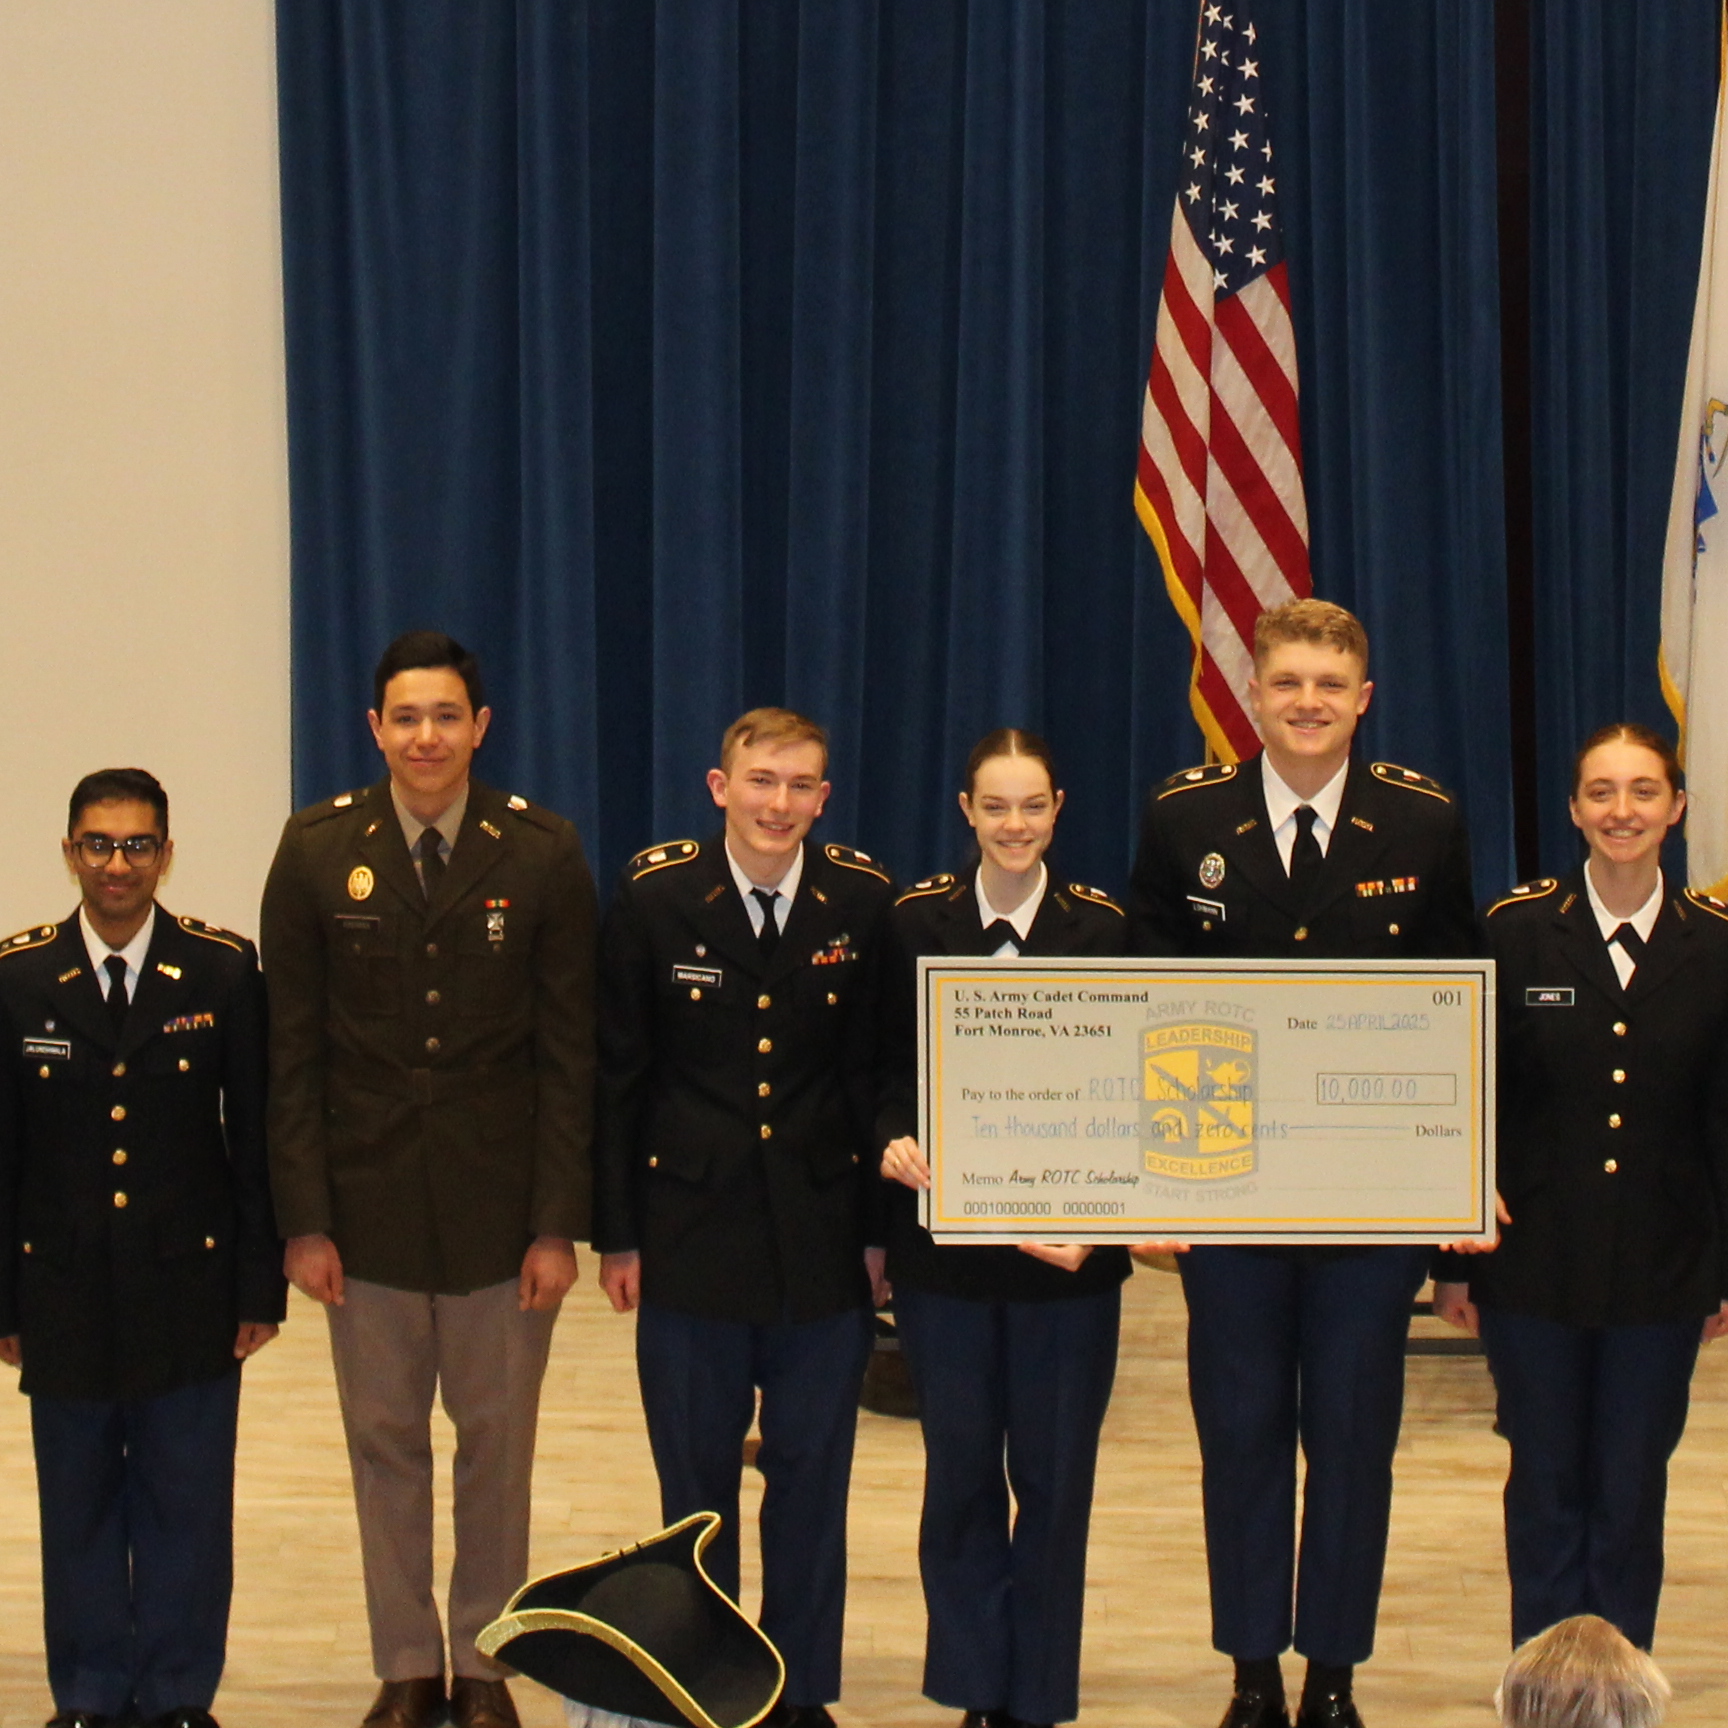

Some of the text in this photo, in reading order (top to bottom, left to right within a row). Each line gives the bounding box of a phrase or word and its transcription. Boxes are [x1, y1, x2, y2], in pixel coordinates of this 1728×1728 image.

[954, 990, 1149, 1005] U. S. Army Cadet Command
[1432, 990, 1463, 1007] 001
[954, 1007, 1053, 1020] 55 Patch Road
[1145, 1000, 1256, 1023] ARMY ROTC
[954, 1024, 1113, 1039] Fort Monroe, VA 23651
[1287, 1017, 1318, 1030] Date
[1146, 1028, 1251, 1049] LEADERSHIP
[962, 1076, 1253, 1106] Pay to the order of ROTC Scholarship
[972, 1115, 998, 1138] Ten
[1005, 1115, 1077, 1139] thousand
[1085, 1115, 1139, 1138] dollars
[1151, 1117, 1183, 1139] and
[1195, 1122, 1233, 1139] zero
[1415, 1123, 1463, 1138] Dollars
[1147, 1154, 1252, 1176] EXCELLENCE
[962, 1169, 1141, 1189] Memo Army ROTC Scholarship
[963, 1201, 1126, 1216] 00010000000 00000001
